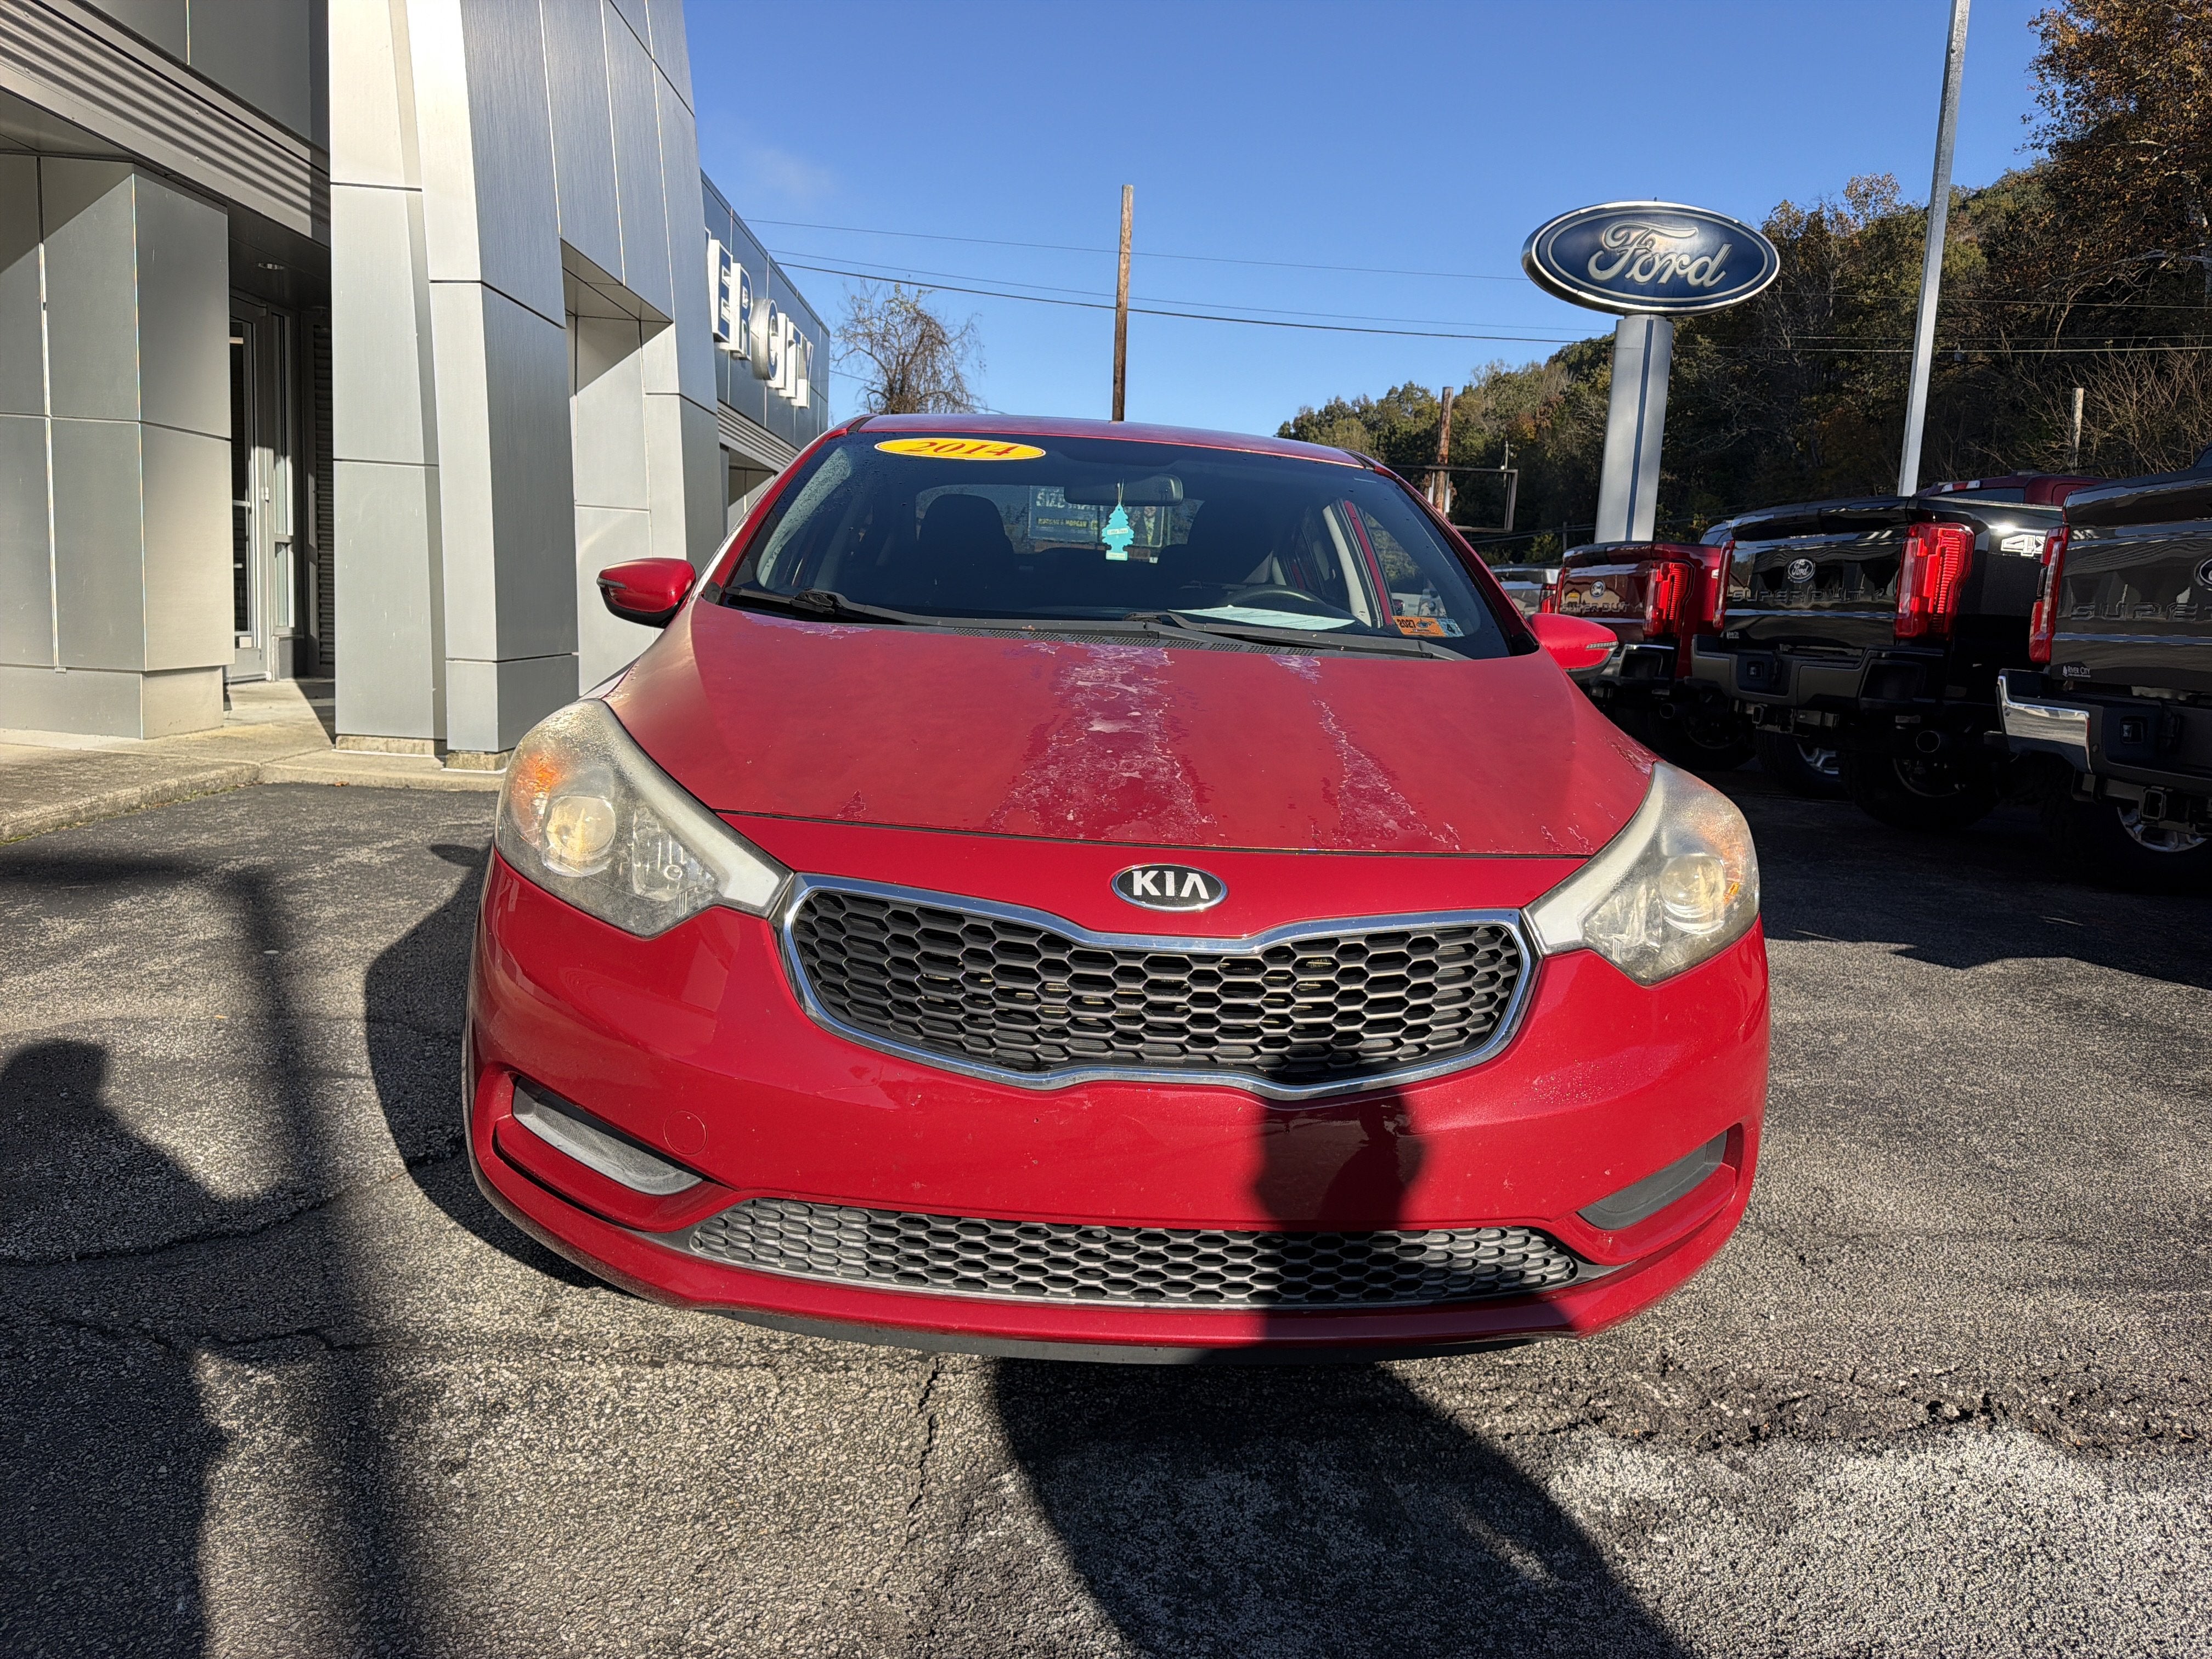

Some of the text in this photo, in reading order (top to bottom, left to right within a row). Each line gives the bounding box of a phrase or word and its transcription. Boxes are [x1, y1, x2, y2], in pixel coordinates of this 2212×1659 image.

[1587, 220, 1733, 289] Ford
[750, 297, 814, 409] CITY
[907, 441, 1019, 456] 2014
[1791, 559, 1810, 576] Ford
[1731, 589, 1805, 602] SUPER
[1561, 602, 1599, 613] SUPER
[1396, 619, 1416, 629] 2027
[1446, 624, 1456, 634] 4
[1131, 870, 1210, 900] KIA
